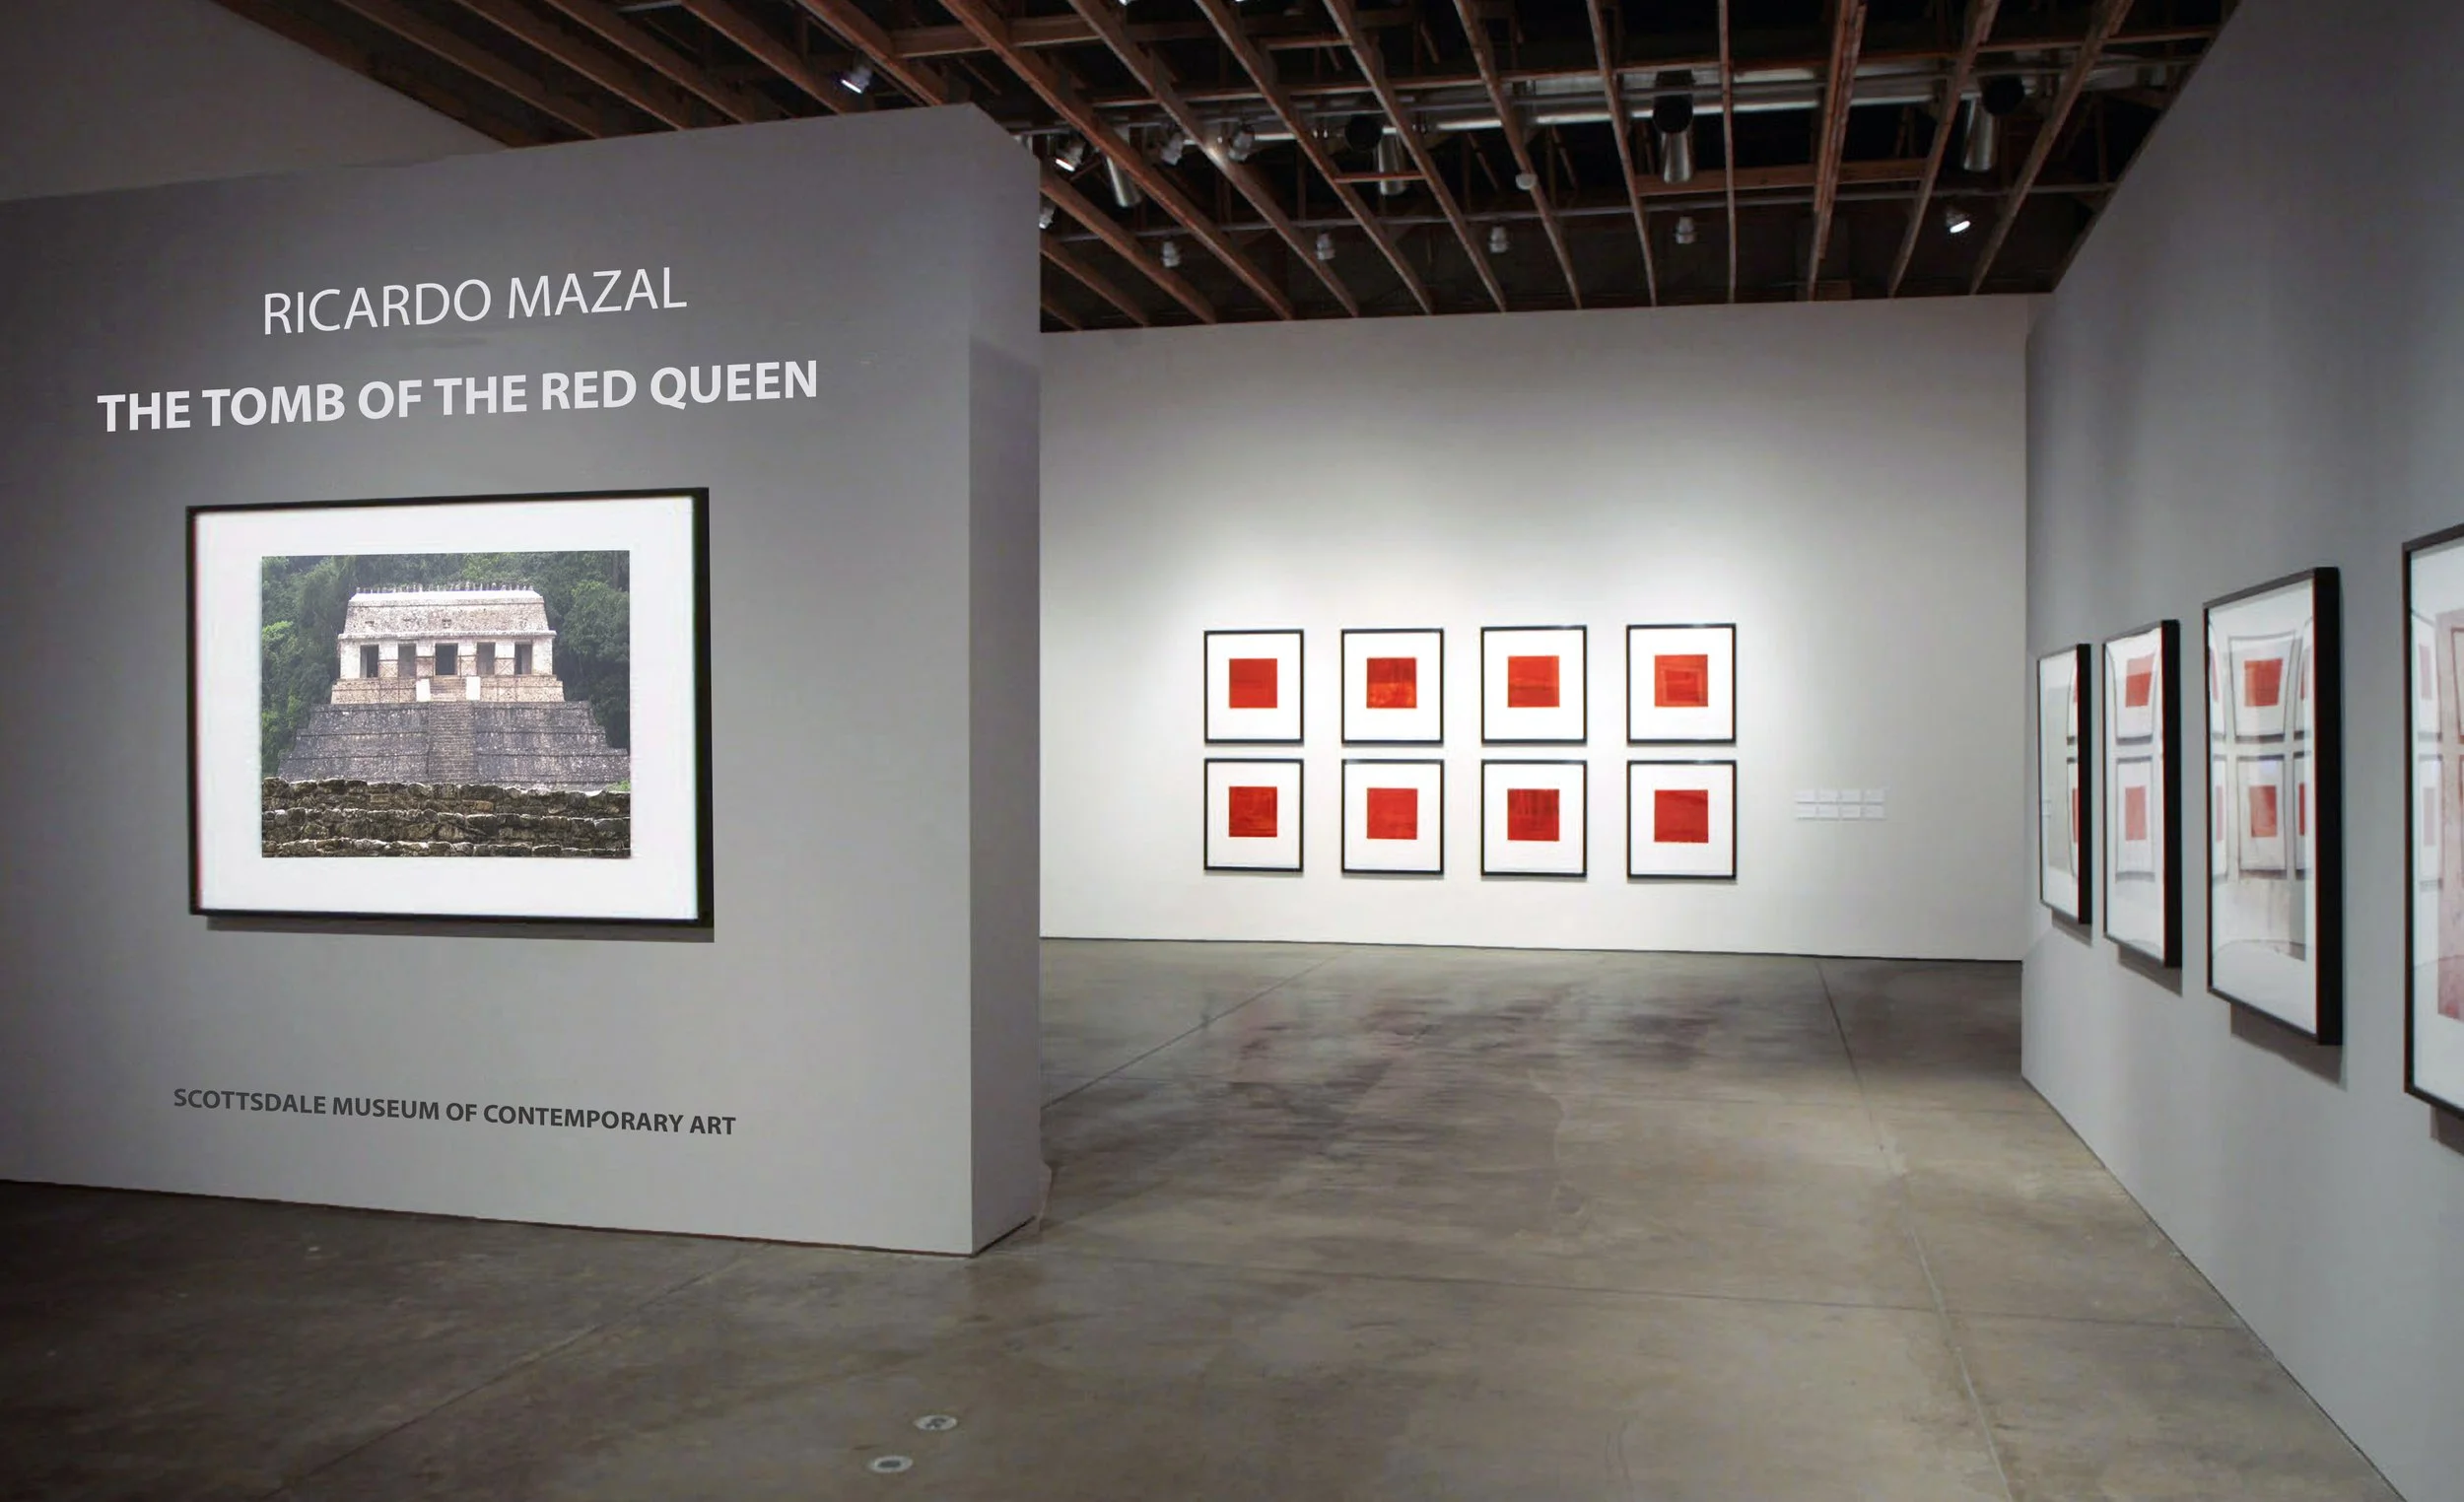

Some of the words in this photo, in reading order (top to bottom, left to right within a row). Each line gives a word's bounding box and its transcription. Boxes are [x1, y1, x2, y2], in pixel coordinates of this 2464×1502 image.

[264, 278, 492, 336] RICARDO
[508, 266, 688, 319] MAZAL
[97, 389, 191, 433] THE
[201, 382, 346, 427] TOMB
[358, 378, 423, 420] OF
[433, 374, 527, 416] THE
[542, 370, 637, 411] RED
[650, 360, 817, 410] QUEEN
[173, 1088, 326, 1115] SCOTTSDALE
[332, 1095, 440, 1121] MUSEUM
[445, 1102, 478, 1123] OF
[483, 1104, 685, 1133] CONTEMPORARY
[689, 1115, 737, 1135] ART
